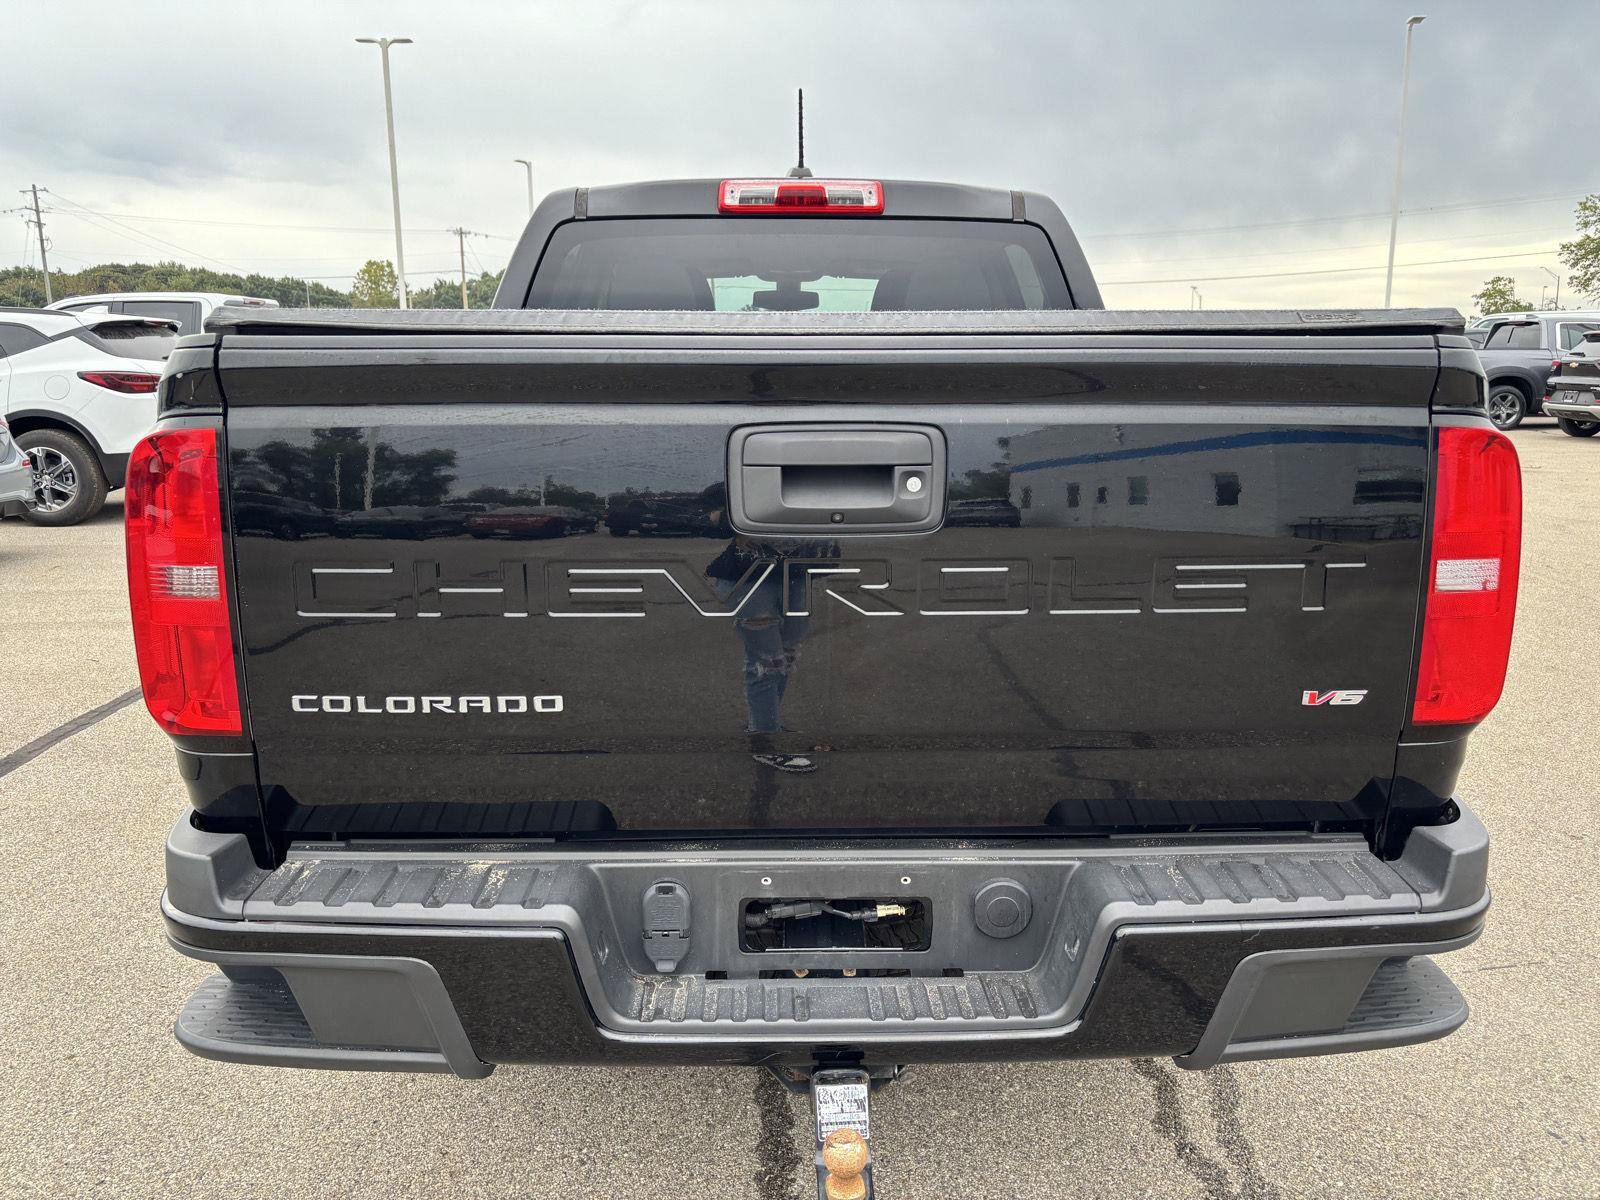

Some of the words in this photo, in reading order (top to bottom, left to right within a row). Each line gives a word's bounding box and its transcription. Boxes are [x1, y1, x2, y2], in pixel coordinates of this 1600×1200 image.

[292, 555, 1367, 619] CHEVROLET
[291, 694, 564, 714] COLORADO
[1301, 689, 1369, 706] V6
